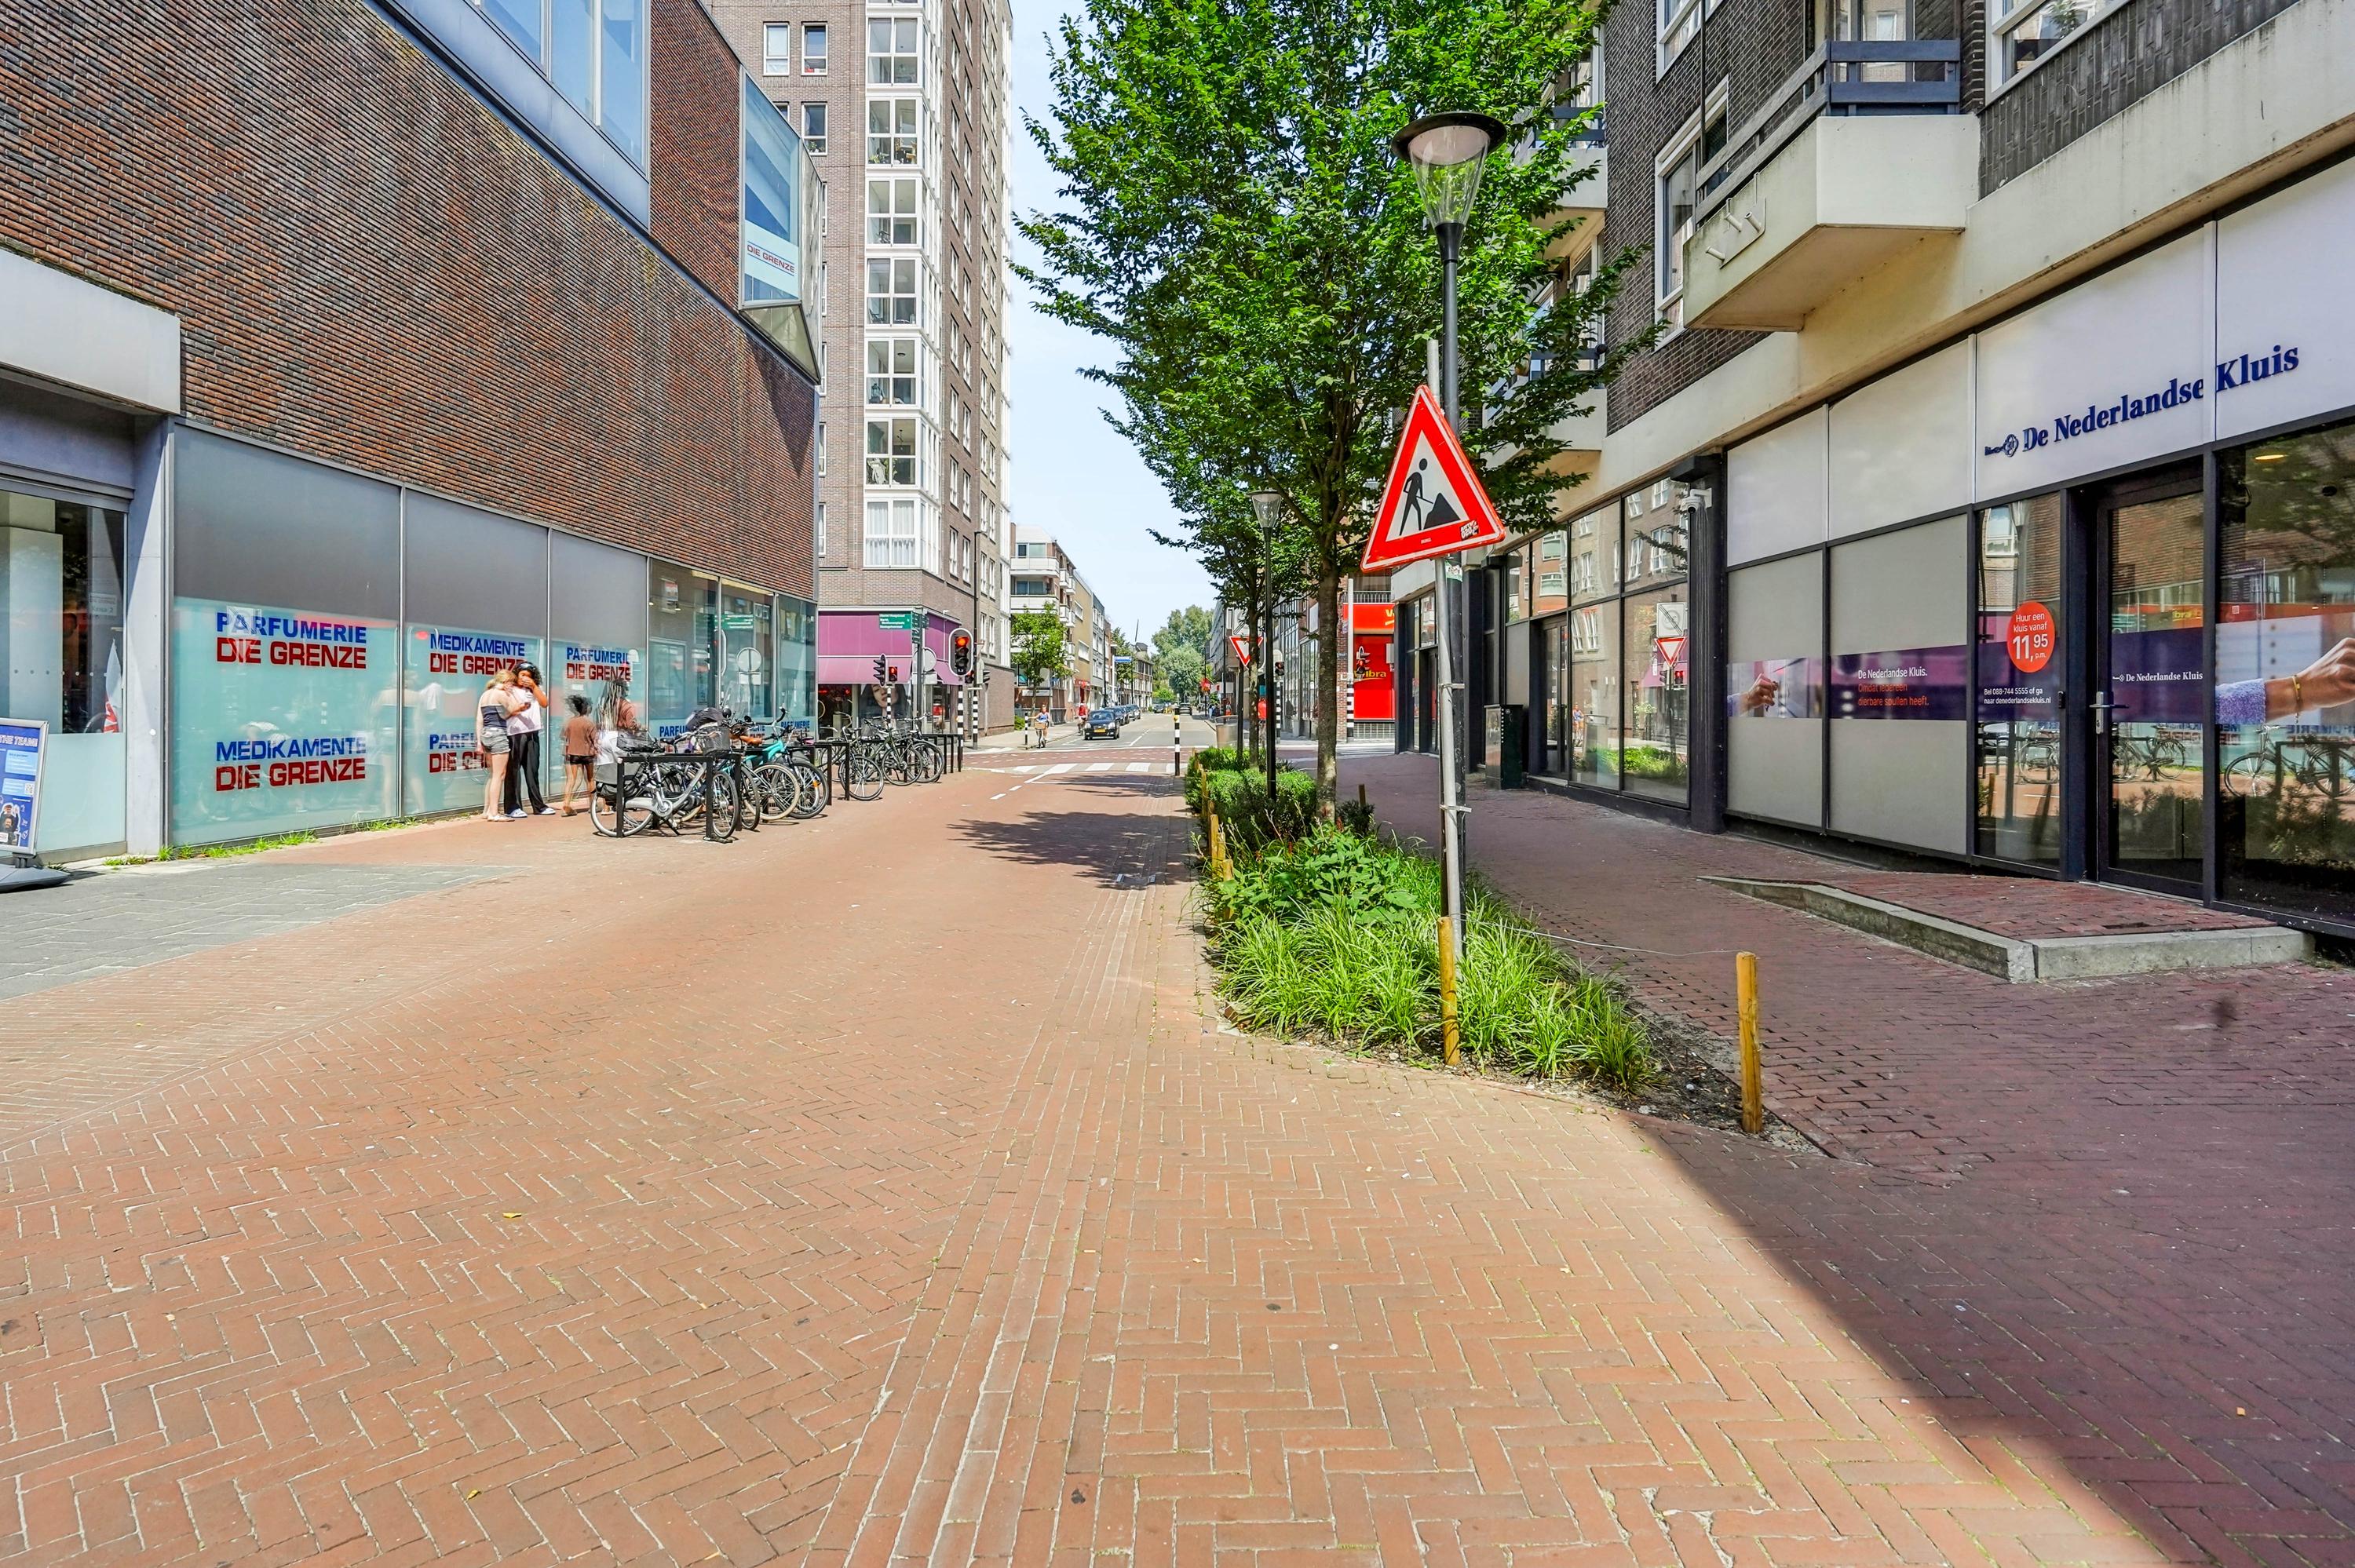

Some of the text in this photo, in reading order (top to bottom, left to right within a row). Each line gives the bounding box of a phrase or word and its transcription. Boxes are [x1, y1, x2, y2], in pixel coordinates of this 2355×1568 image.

[747, 244, 795, 273] DIE GRENZE
[2022, 344, 2299, 453] De Nederlandse Kluis
[217, 612, 367, 644] PARFUMERIE
[2014, 622, 2048, 633] kluis vanaf
[217, 636, 367, 669] DIE GRENZE
[430, 633, 525, 657] MEDIKAMENTE
[430, 653, 526, 676] DIE GRENZ
[567, 663, 631, 682] DIE GRENZE
[1858, 666, 1928, 680] De Nederlandse Kluis.
[1858, 684, 1908, 692] Omdat iedereen
[2126, 671, 2203, 682] De Nederlandse Kluis
[1858, 697, 1883, 706] dierbare
[1884, 697, 1908, 707] spullen
[216, 736, 367, 761] MEDIKAMENTE
[429, 752, 457, 773] DIE
[216, 758, 366, 792] DIE GRENZE
